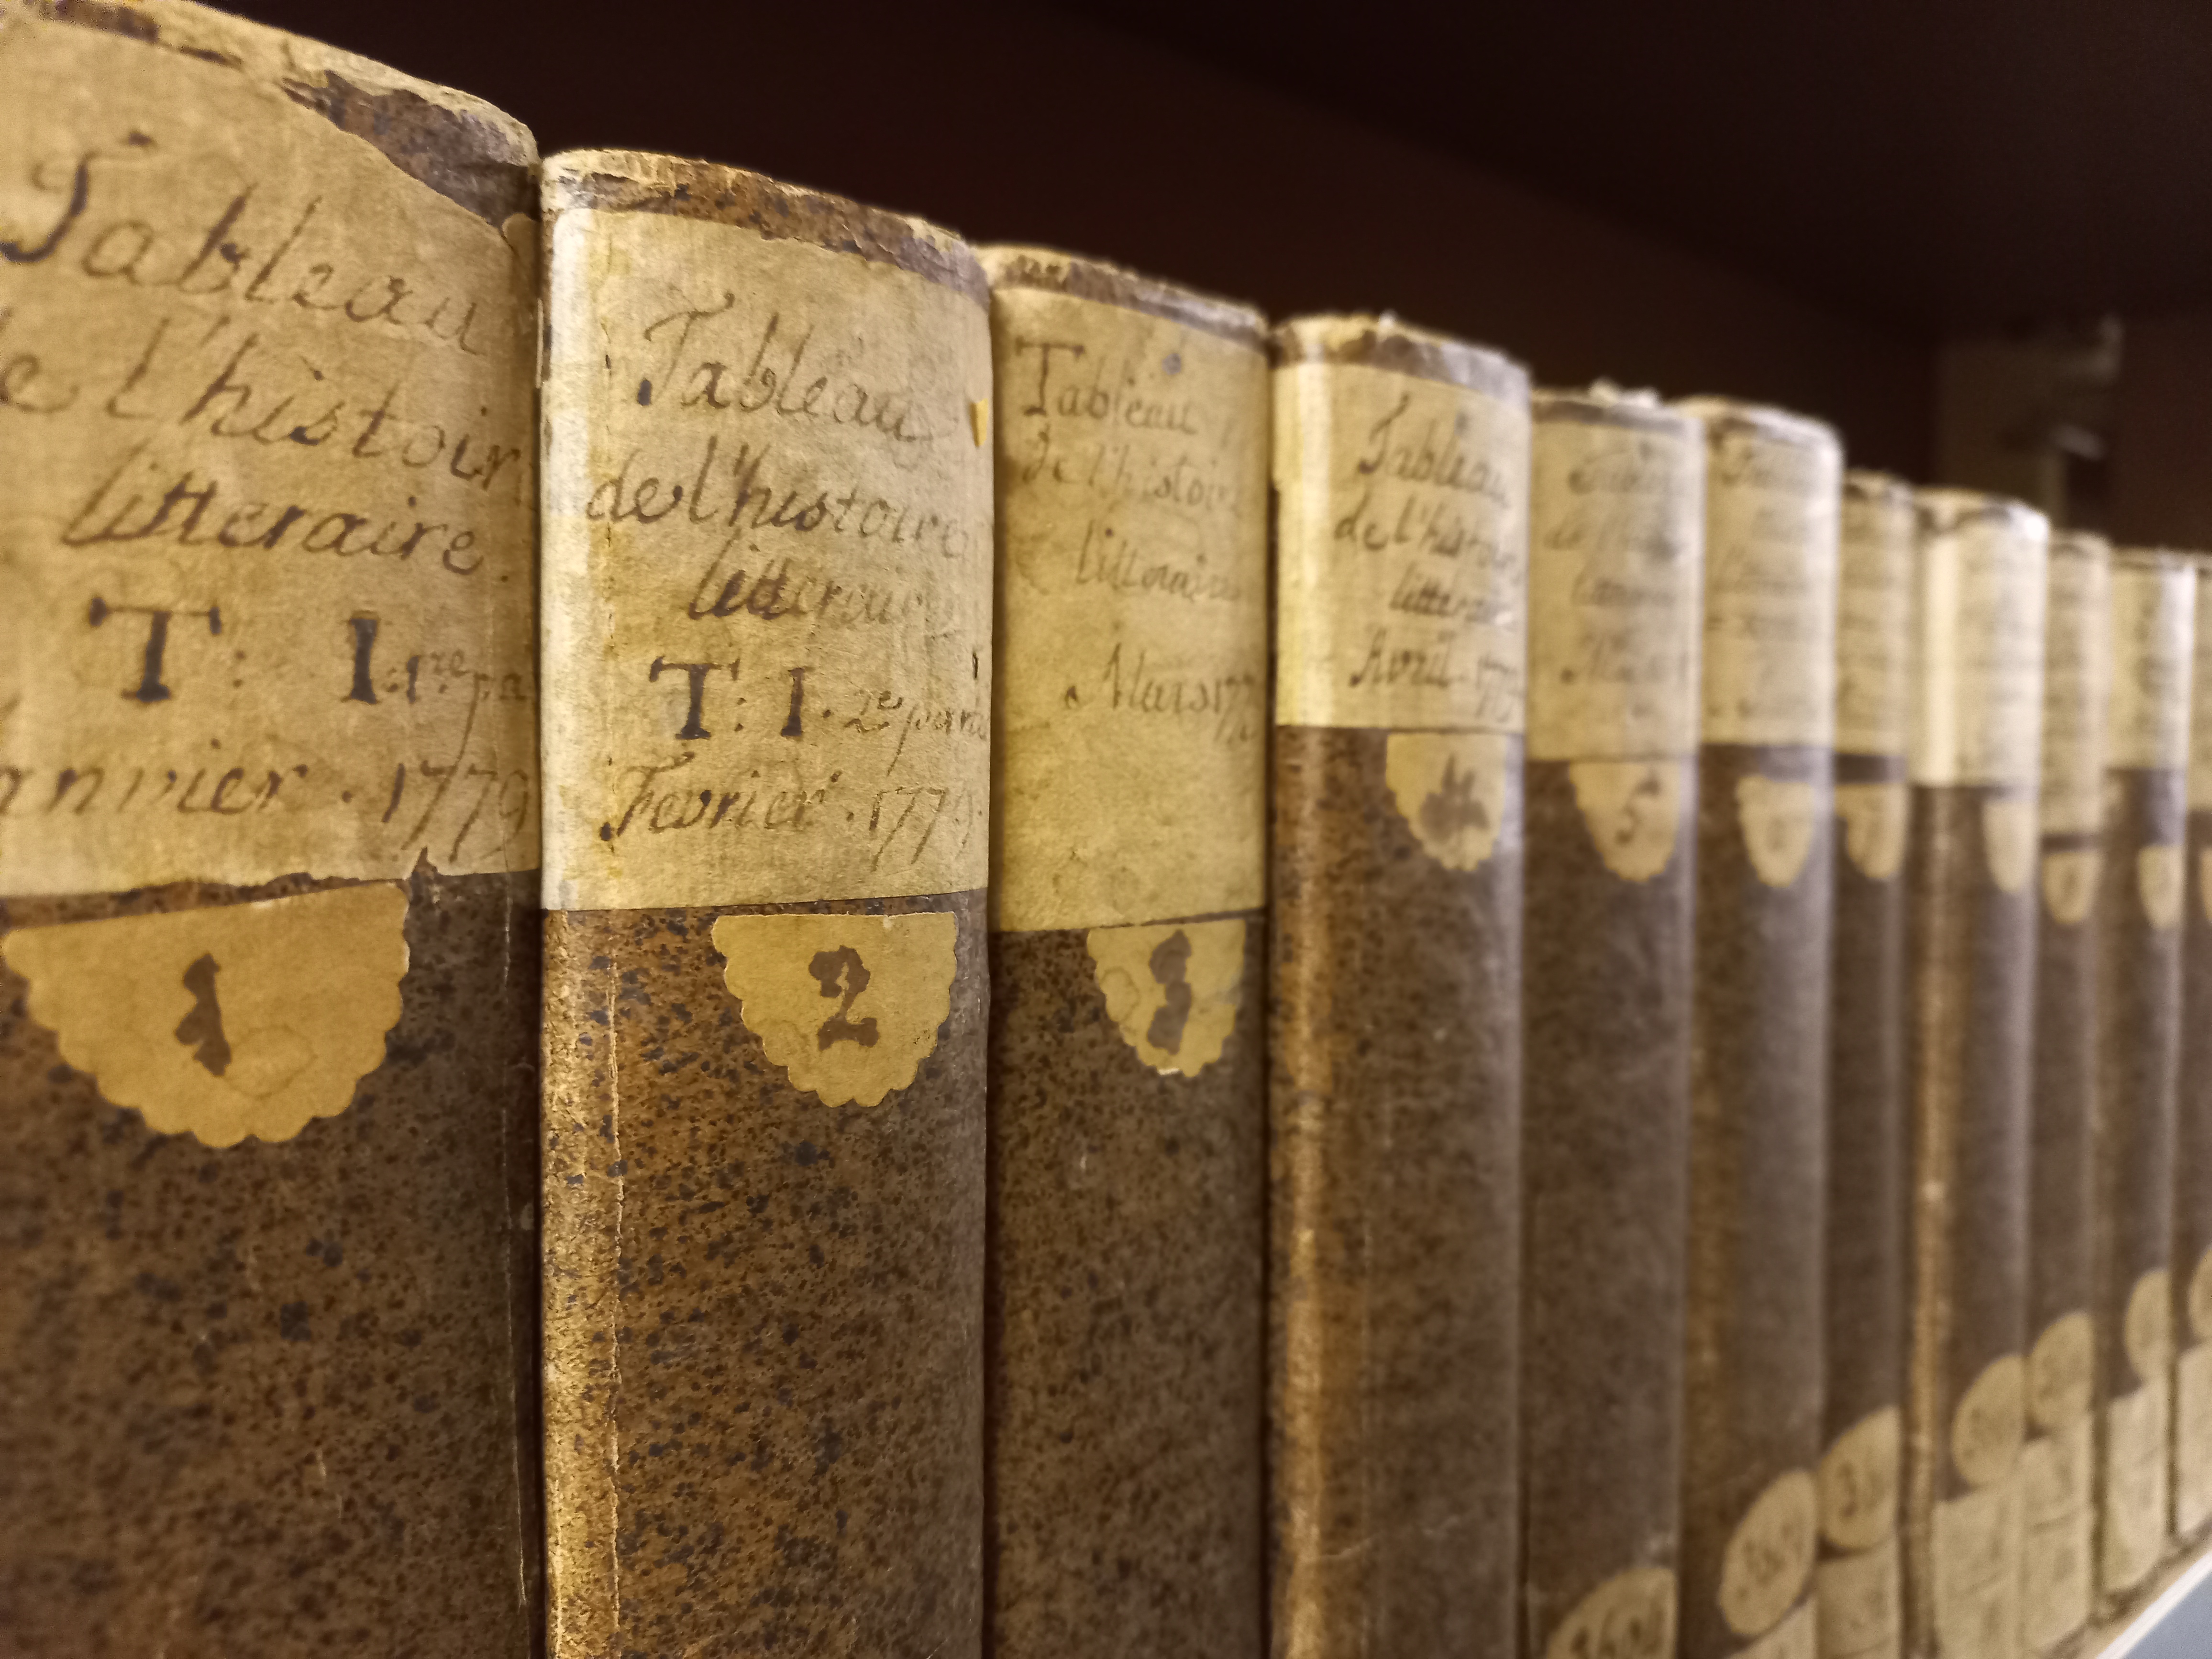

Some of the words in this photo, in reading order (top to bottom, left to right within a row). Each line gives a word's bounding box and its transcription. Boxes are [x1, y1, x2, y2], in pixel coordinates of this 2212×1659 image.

[637, 292, 957, 442] Tableau
[174, 952, 232, 1076] 1
[808, 945, 880, 1051] 2
